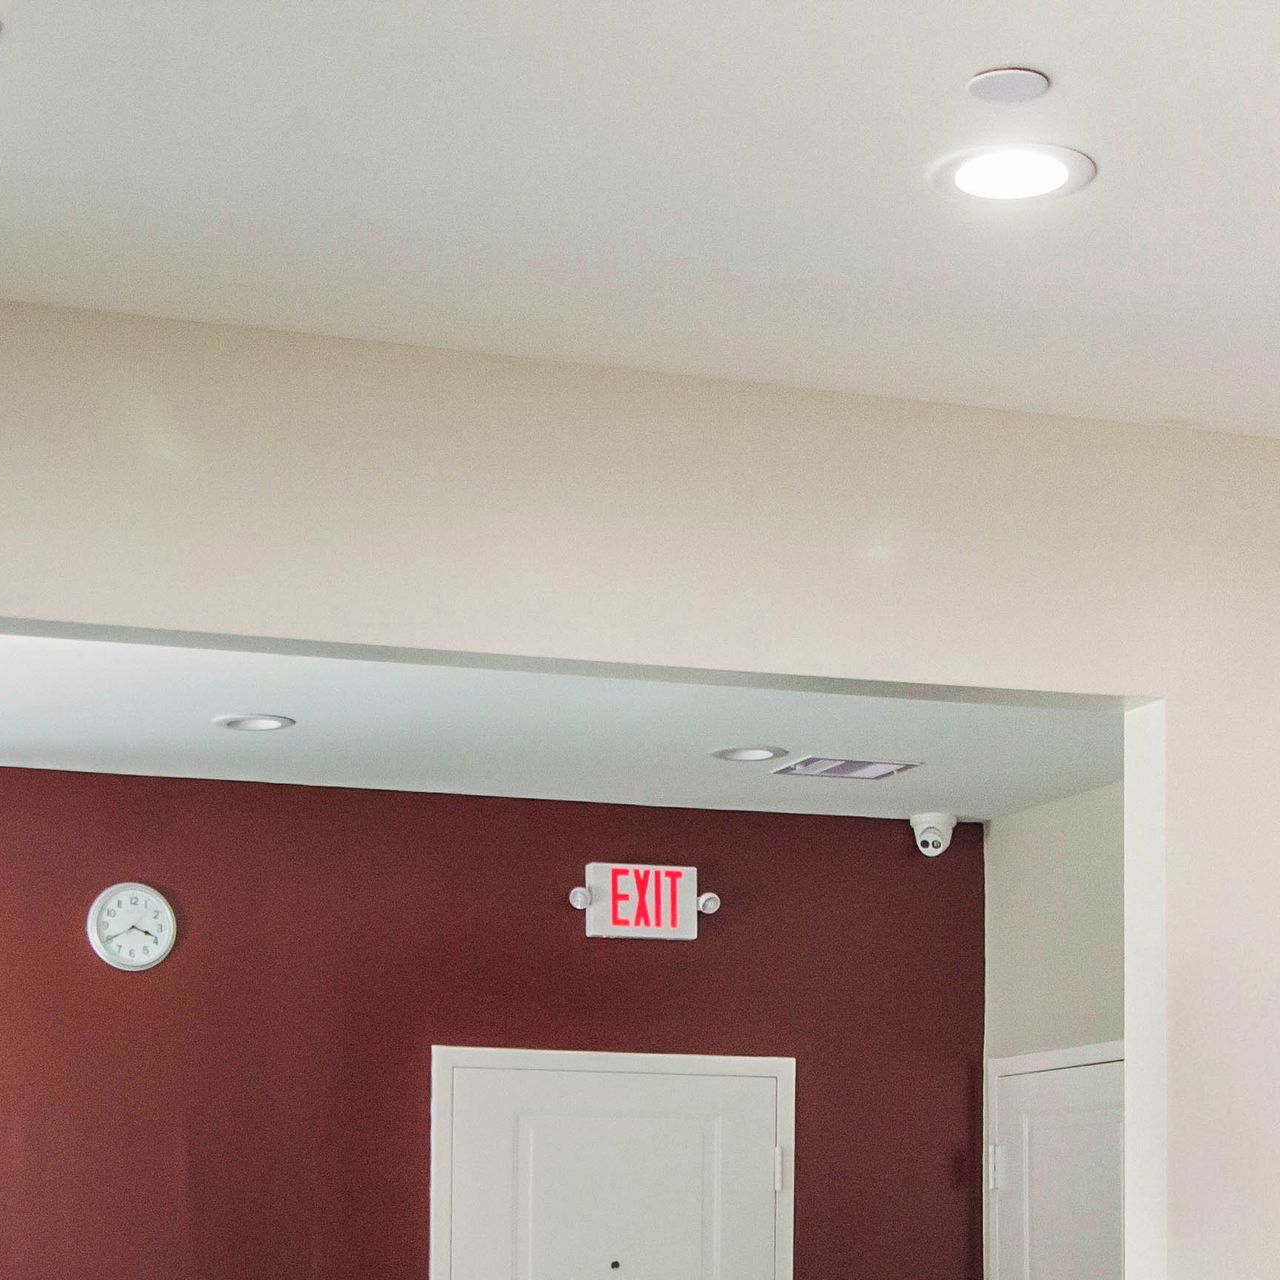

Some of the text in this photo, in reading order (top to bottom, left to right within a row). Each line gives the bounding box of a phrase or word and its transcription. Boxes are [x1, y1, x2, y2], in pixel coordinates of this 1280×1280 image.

[129, 896, 139, 906] 12
[610, 867, 684, 929] EXIT
[106, 908, 117, 919] 10
[152, 910, 160, 920] 2
[102, 920, 109, 930] 9
[116, 944, 122, 954] 7
[128, 948, 136, 959] 6
[142, 945, 150, 955] 5
